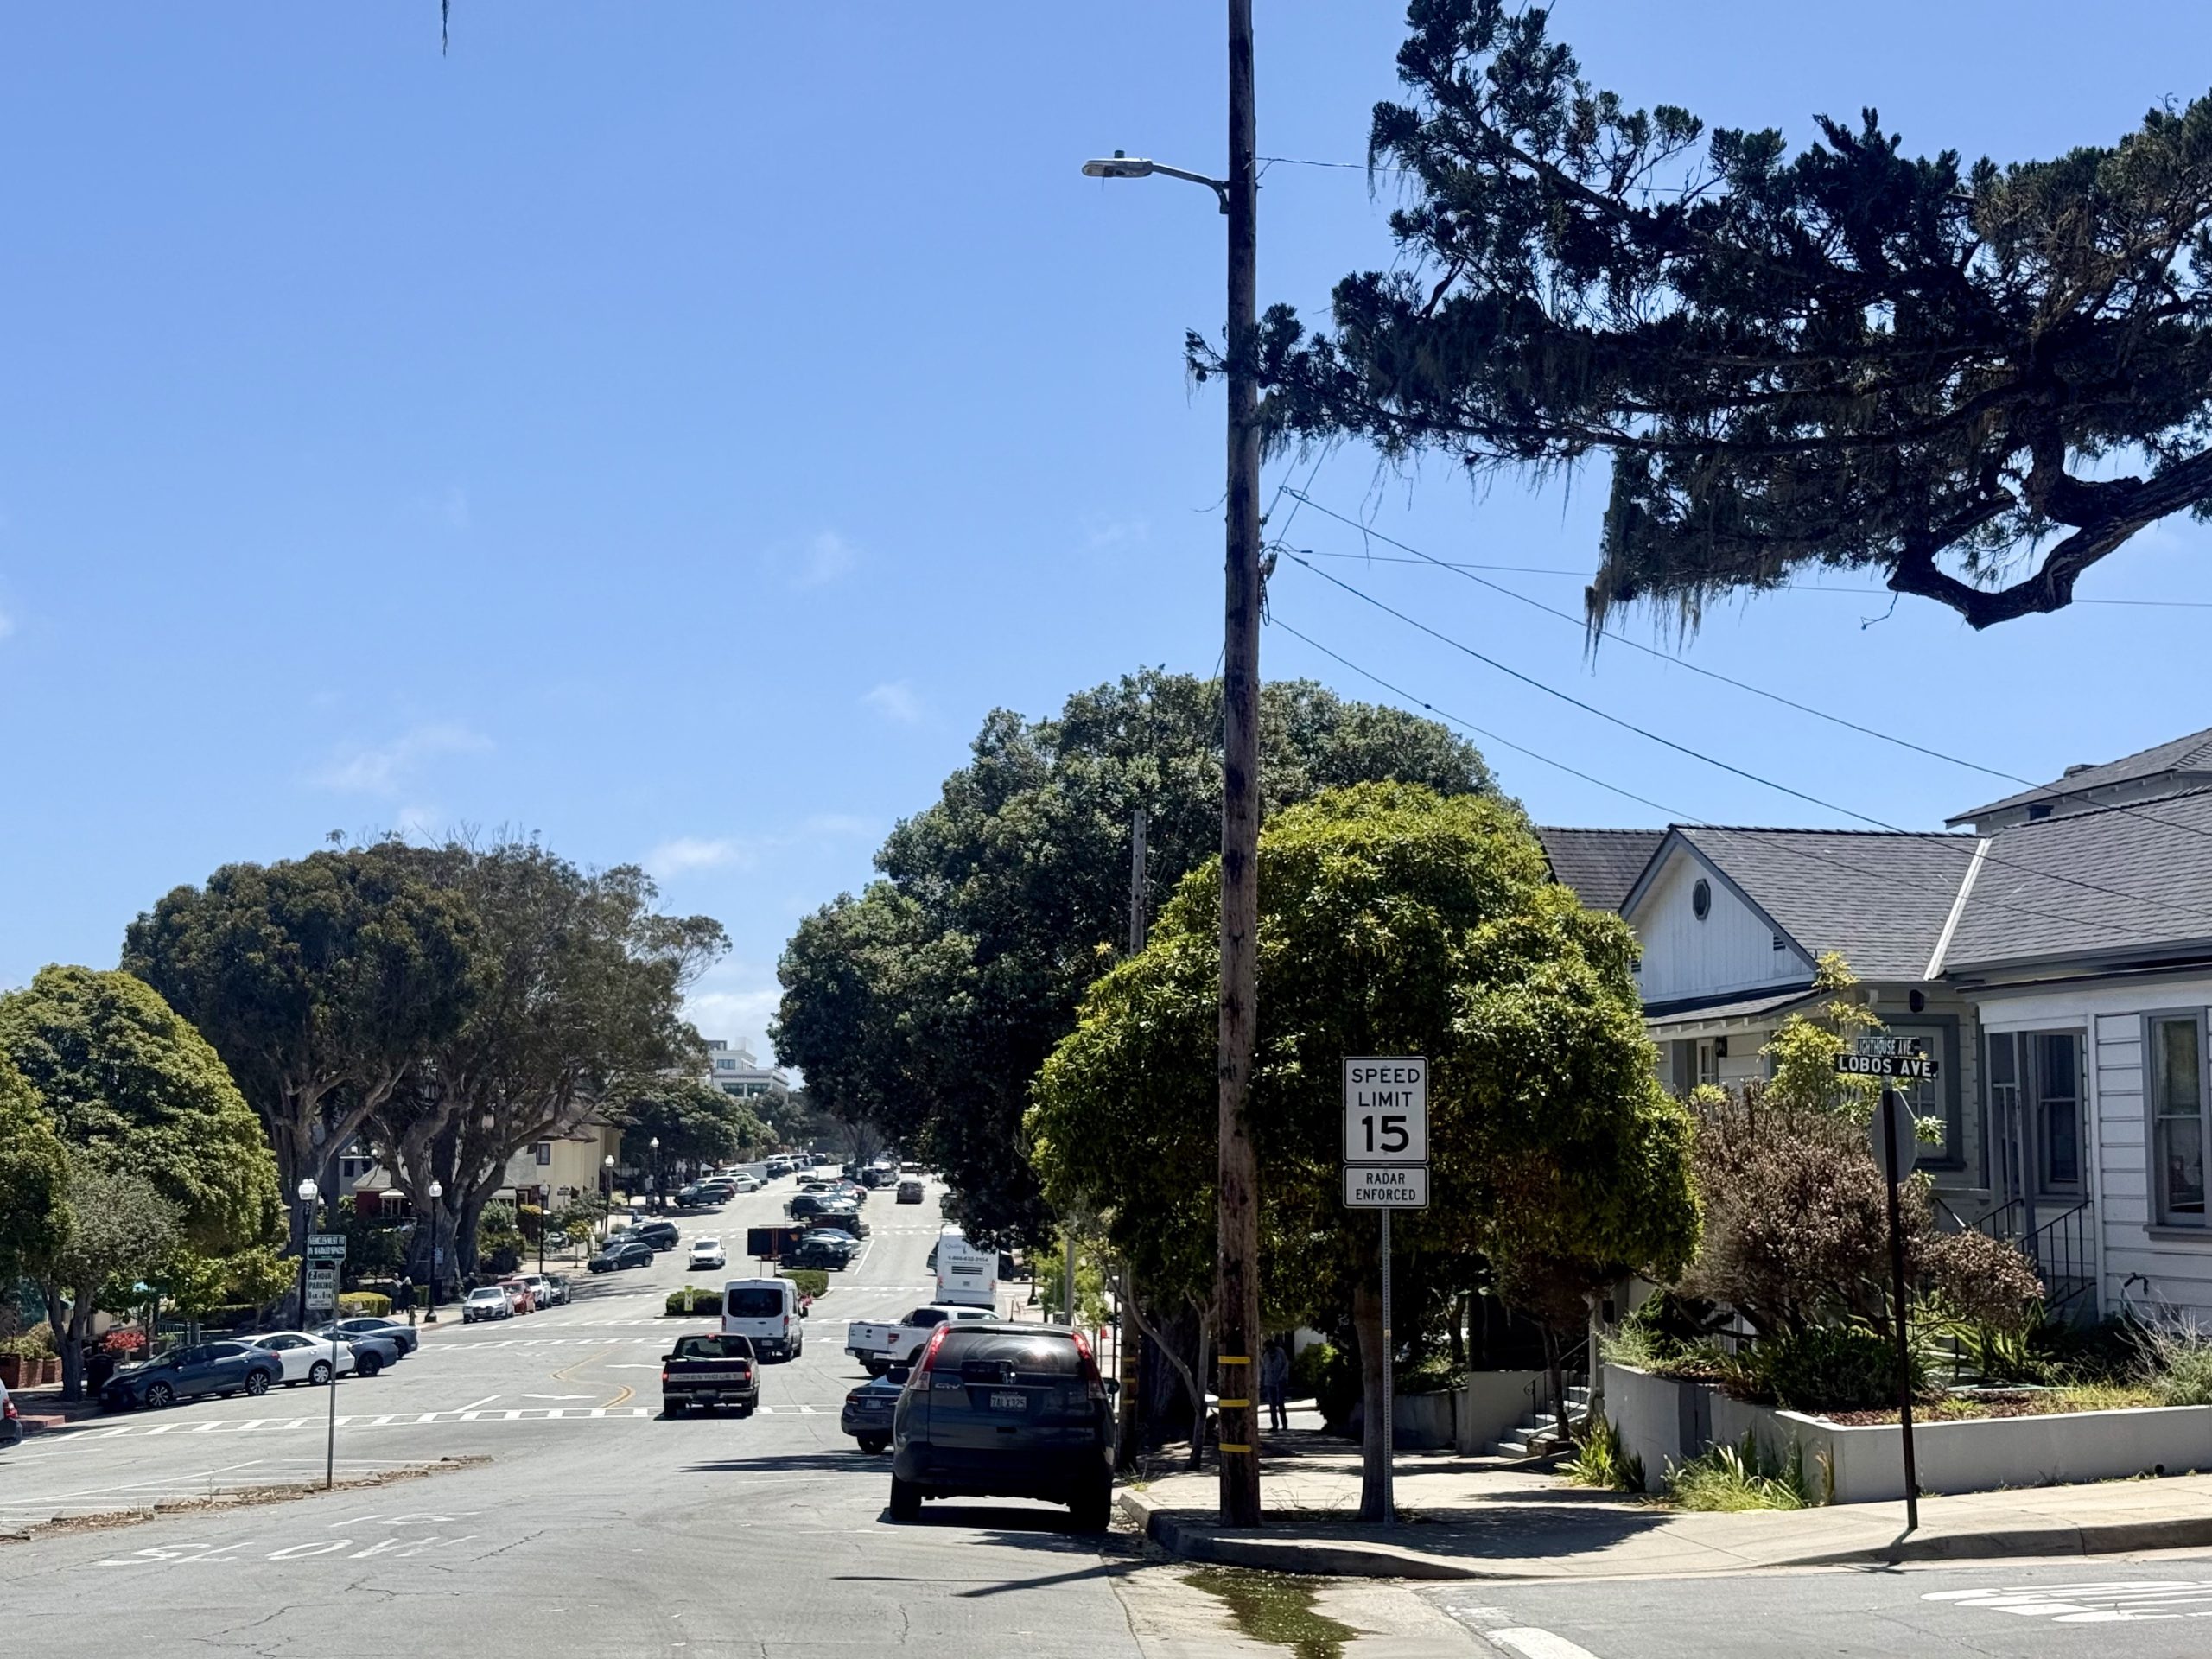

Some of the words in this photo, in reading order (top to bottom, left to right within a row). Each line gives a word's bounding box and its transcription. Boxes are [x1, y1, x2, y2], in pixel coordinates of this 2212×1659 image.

[1839, 1056, 1892, 1074] LOBOS
[1351, 1068, 1421, 1083] SPEED
[1358, 1091, 1413, 1107] LIMIT
[1362, 1116, 1409, 1153] 15
[1366, 1173, 1405, 1185] RADAR
[1356, 1188, 1416, 1200] ENFORCED
